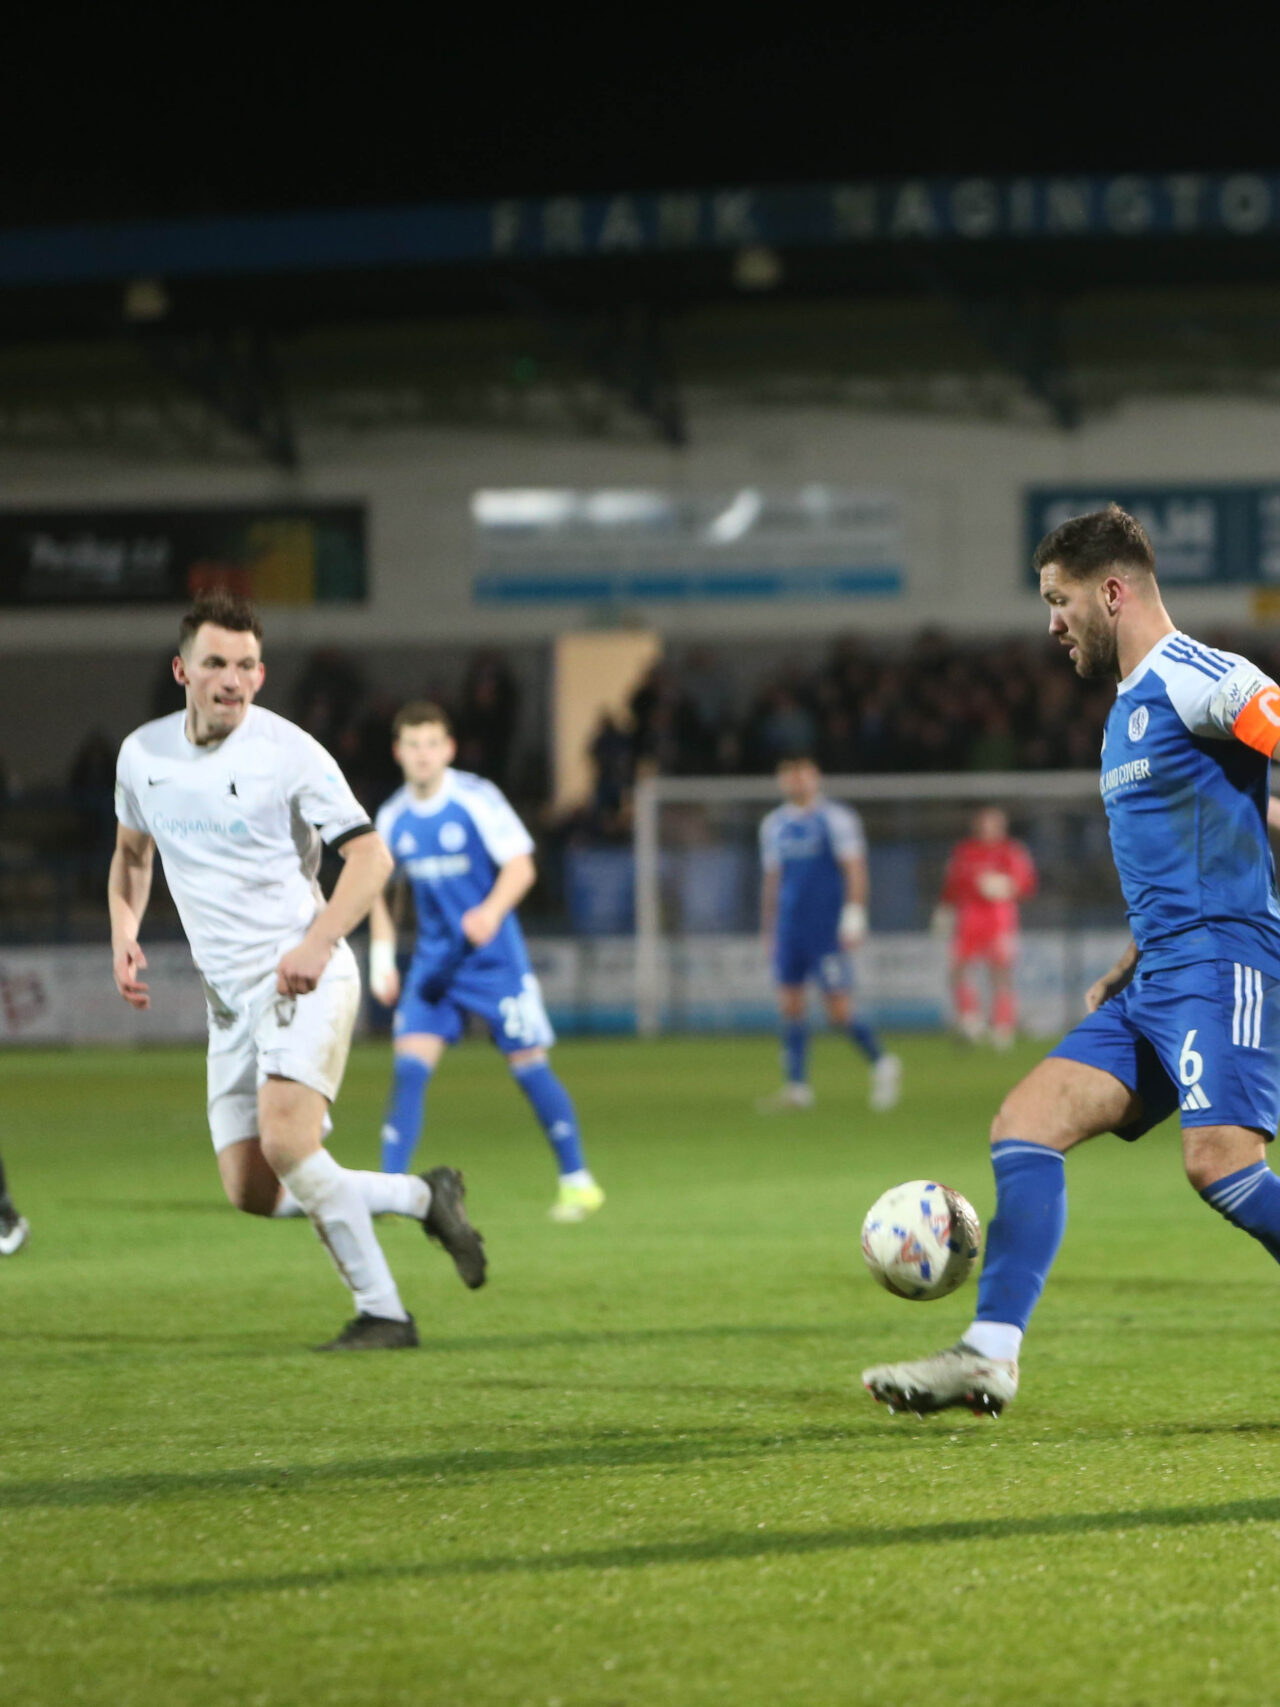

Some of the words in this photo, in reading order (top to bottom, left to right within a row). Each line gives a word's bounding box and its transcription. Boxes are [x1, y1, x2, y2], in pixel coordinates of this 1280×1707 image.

[491, 188, 756, 254] FRANK
[152, 810, 228, 839] Capgemini
[1178, 1029, 1204, 1087] 6
